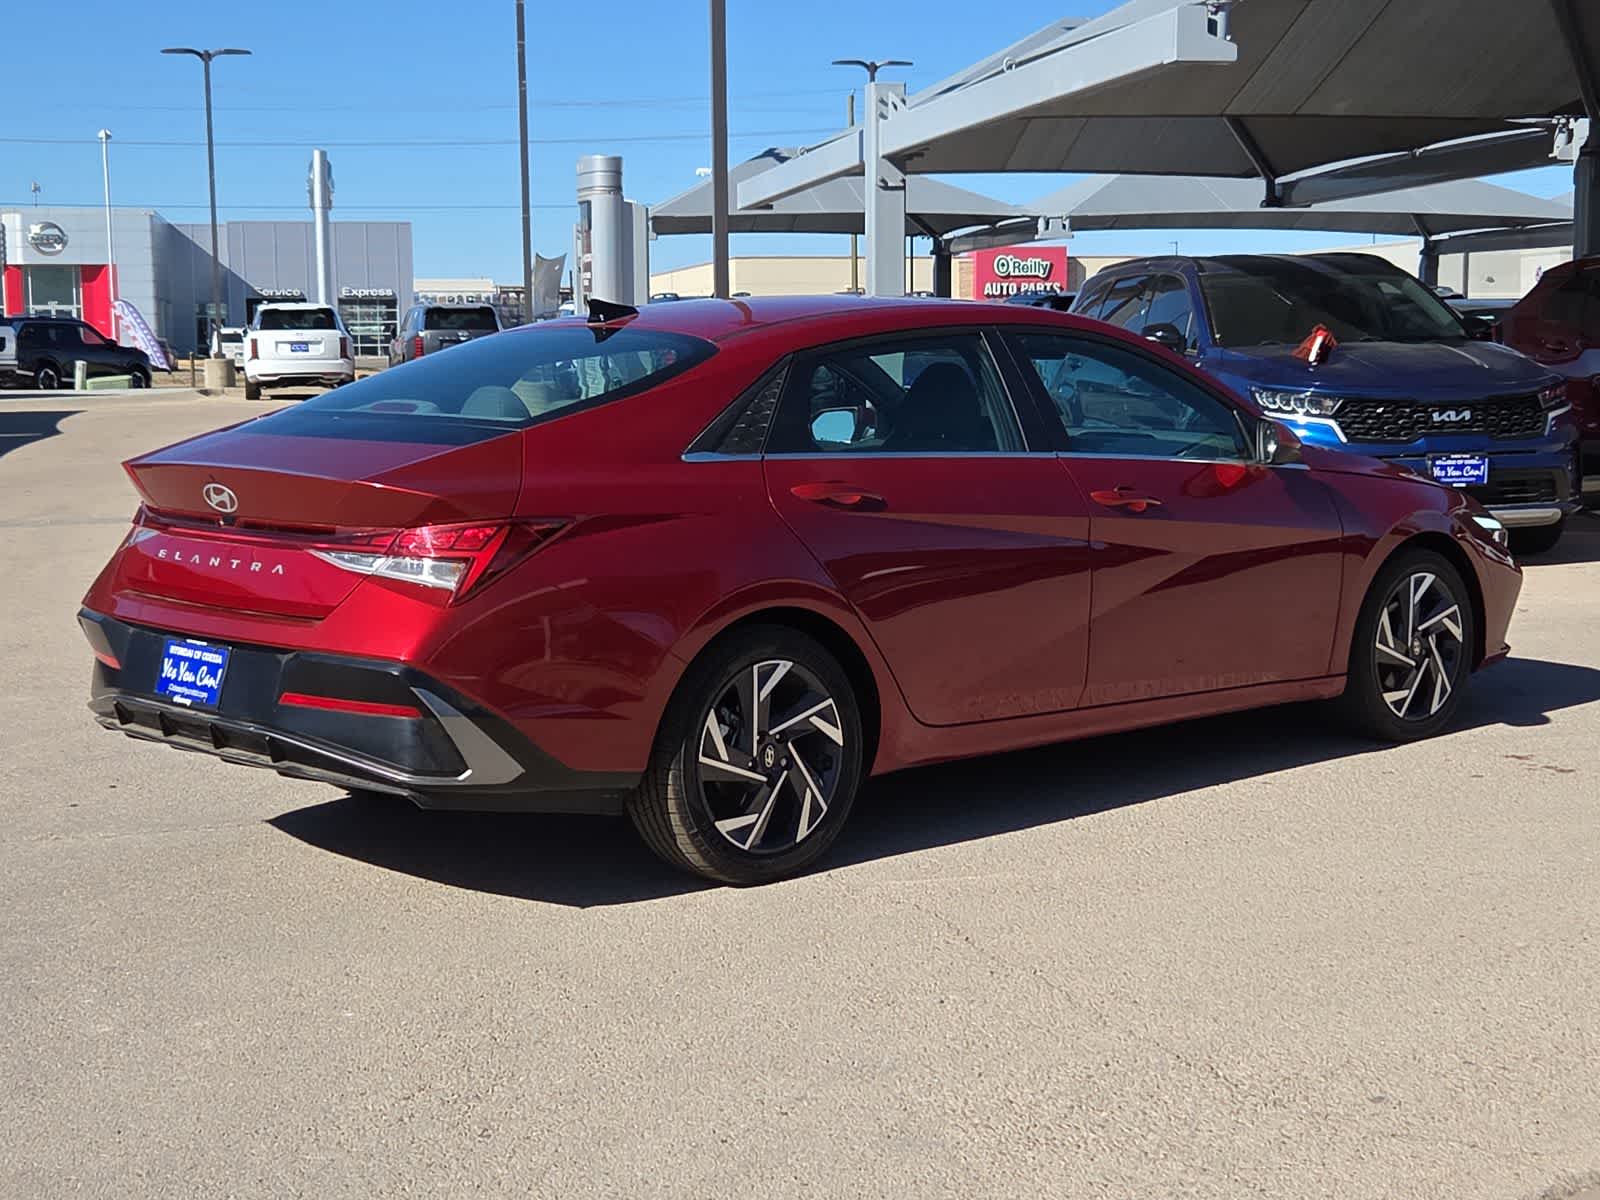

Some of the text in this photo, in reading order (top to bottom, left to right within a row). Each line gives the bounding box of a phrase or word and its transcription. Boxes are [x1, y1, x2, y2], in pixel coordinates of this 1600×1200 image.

[995, 256, 1050, 277] O'Reilly
[255, 287, 301, 297] Service
[341, 287, 393, 298] Express
[984, 282, 1061, 295] AUTO PARTS
[1433, 466, 1446, 477] Yes
[1447, 466, 1462, 477] You
[158, 549, 284, 575] ELANTRA
[162, 658, 223, 689] Yes You Can!
